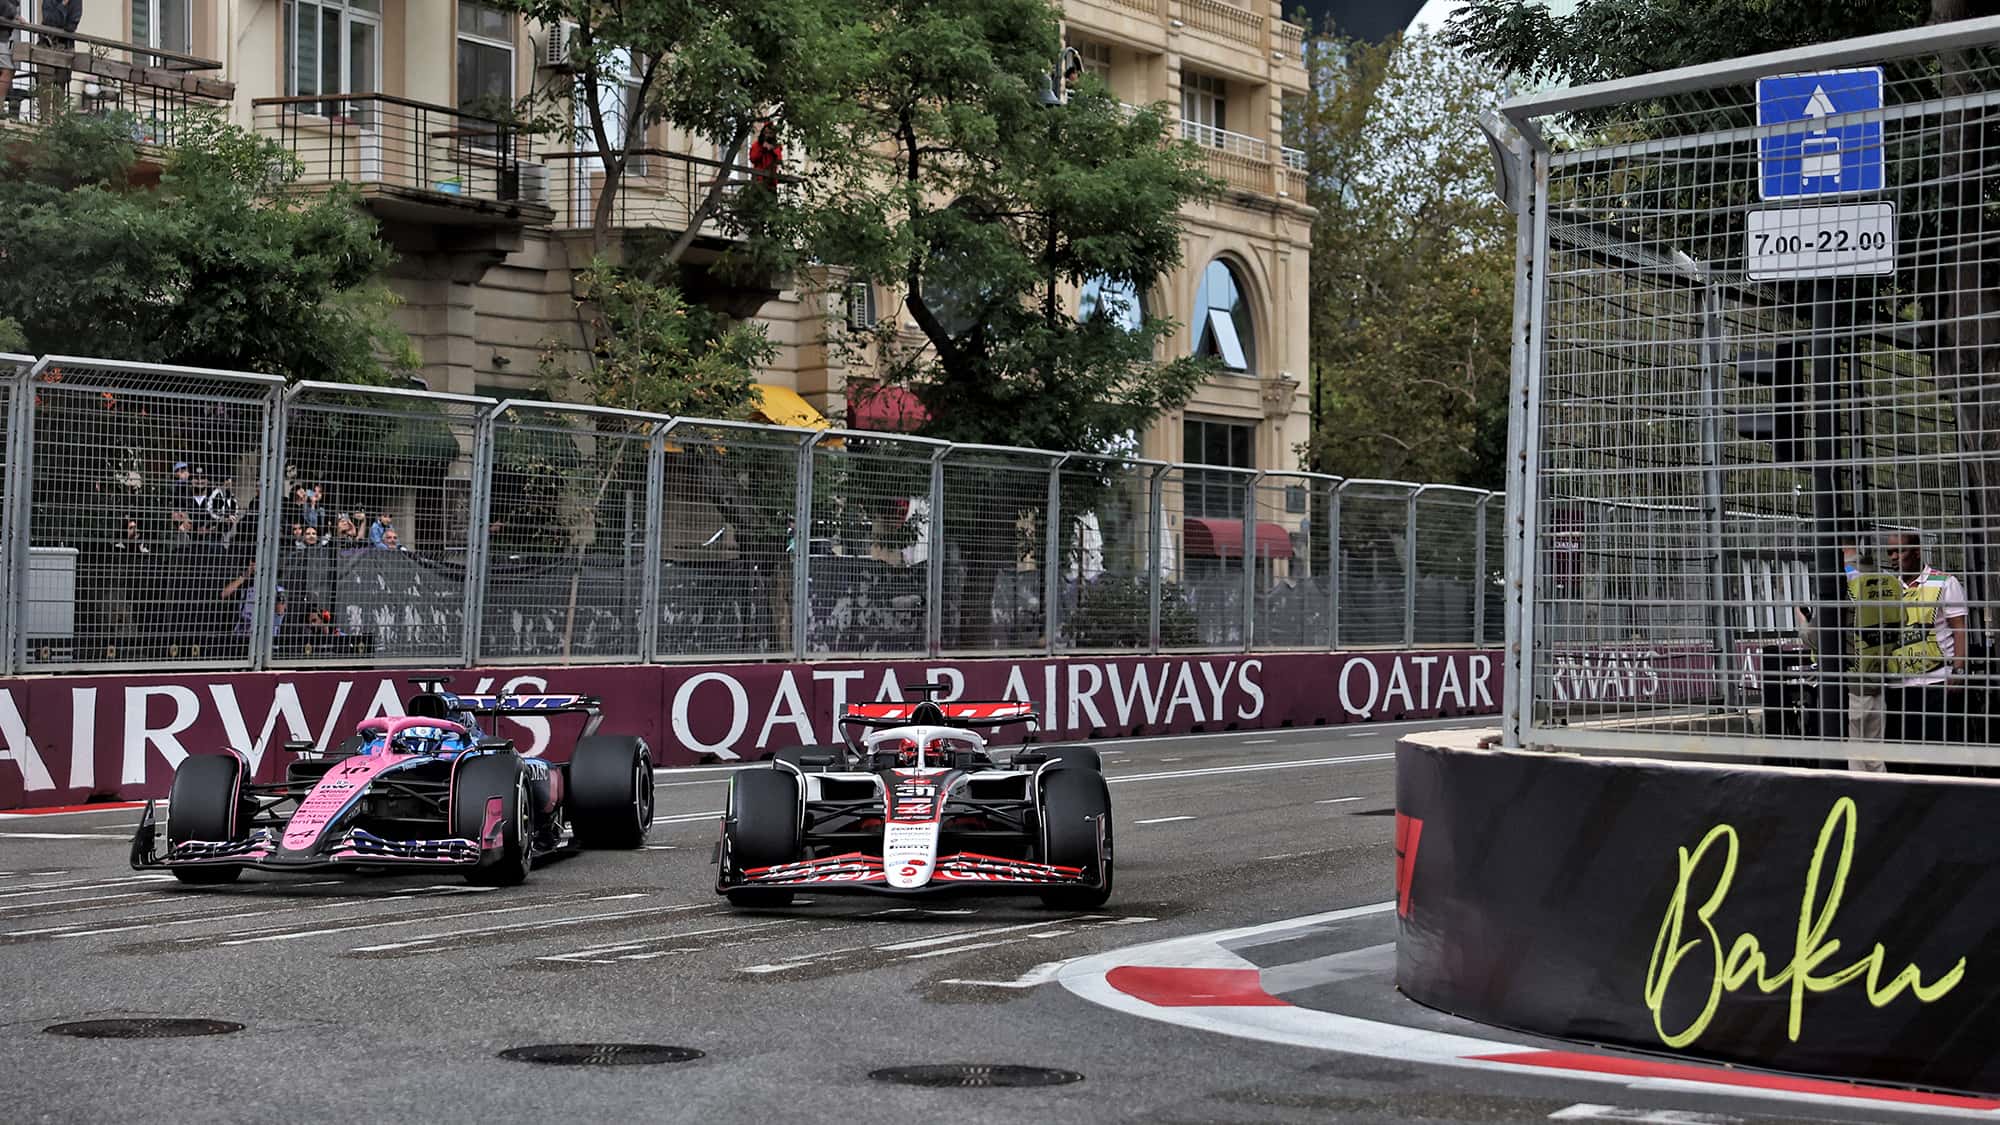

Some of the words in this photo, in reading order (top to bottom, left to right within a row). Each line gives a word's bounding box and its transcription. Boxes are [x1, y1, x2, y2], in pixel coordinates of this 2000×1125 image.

[1755, 230, 1886, 256] 7.00-22.00
[990, 659, 1264, 734] AIRWAYS
[1338, 654, 1495, 719] QATAR
[1551, 650, 1658, 701] RWAYS
[0, 675, 551, 792] AIRWAS
[1645, 796, 1967, 1048] Baku
